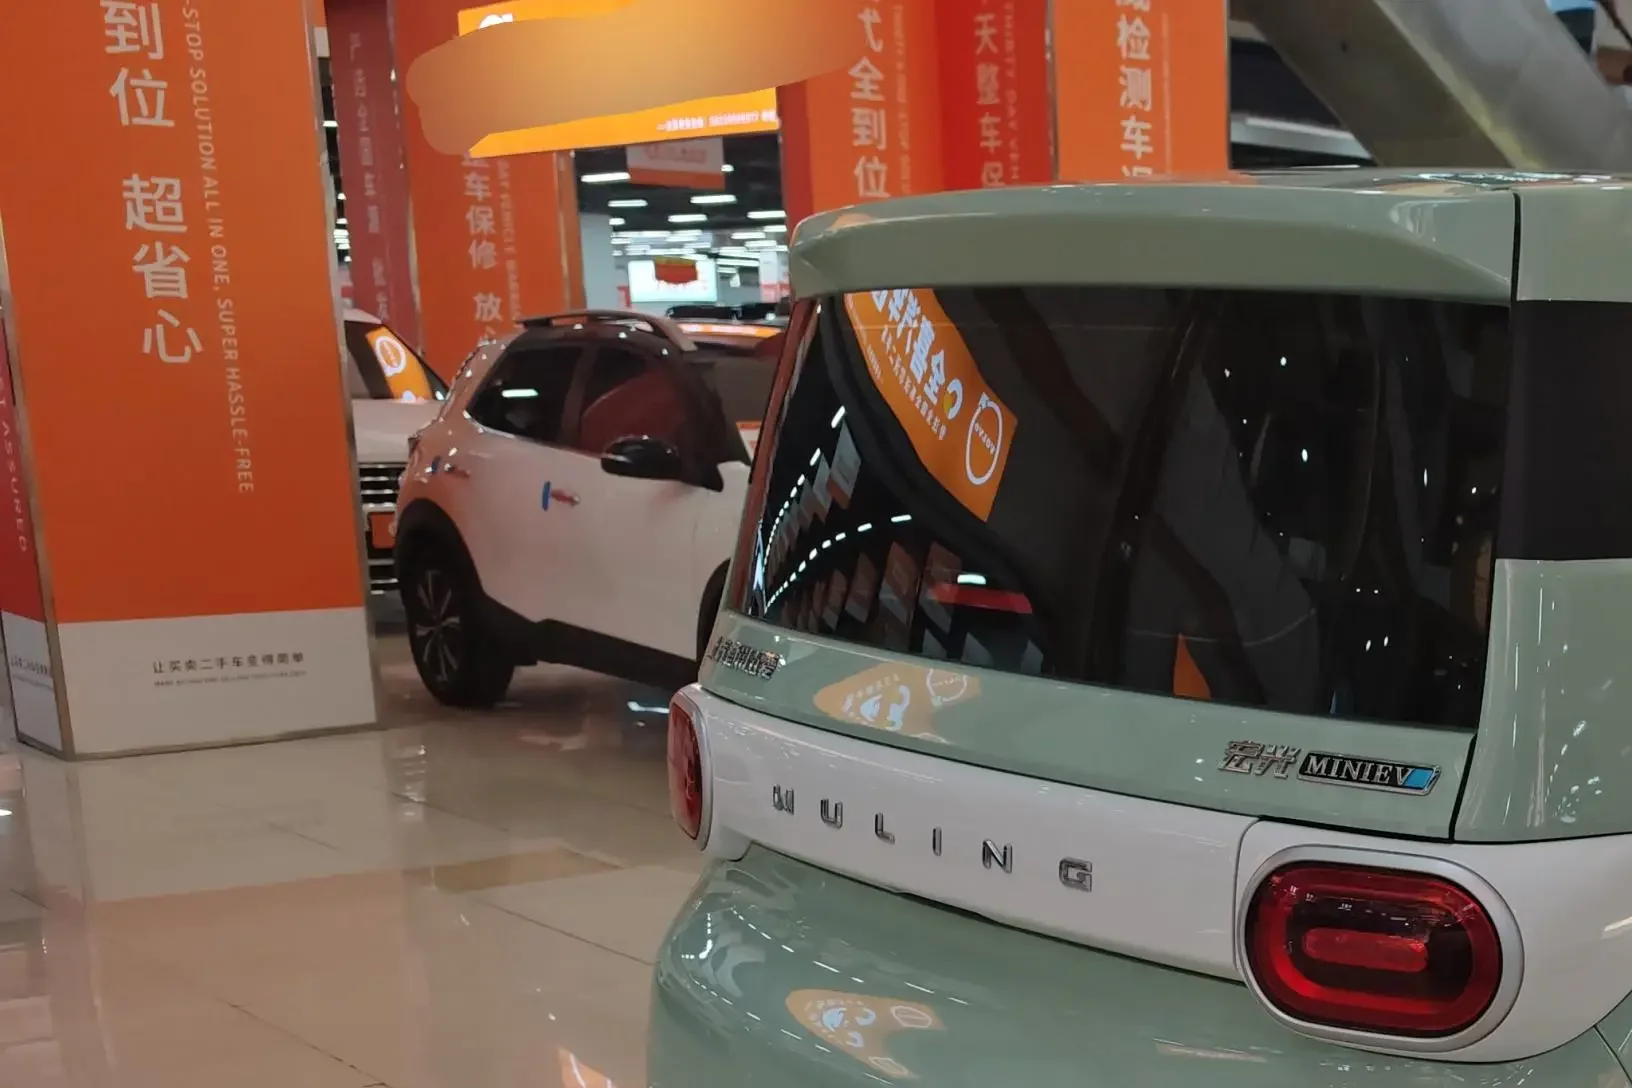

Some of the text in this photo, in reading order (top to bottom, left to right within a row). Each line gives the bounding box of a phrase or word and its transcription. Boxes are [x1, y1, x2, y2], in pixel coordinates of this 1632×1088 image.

[189, 68, 217, 170] SOLUTION
[1113, 0, 1153, 177] 检测车
[100, 0, 204, 364] 到位 超省心
[202, 176, 221, 211] ALL
[206, 218, 225, 238] IN
[210, 245, 231, 292] ONE,
[216, 298, 239, 360] SUPER
[225, 367, 254, 493] HASSLE-FREE
[1217, 740, 1301, 779] 宏光
[1304, 755, 1415, 787] MINIEV
[772, 784, 1094, 893] WULING
